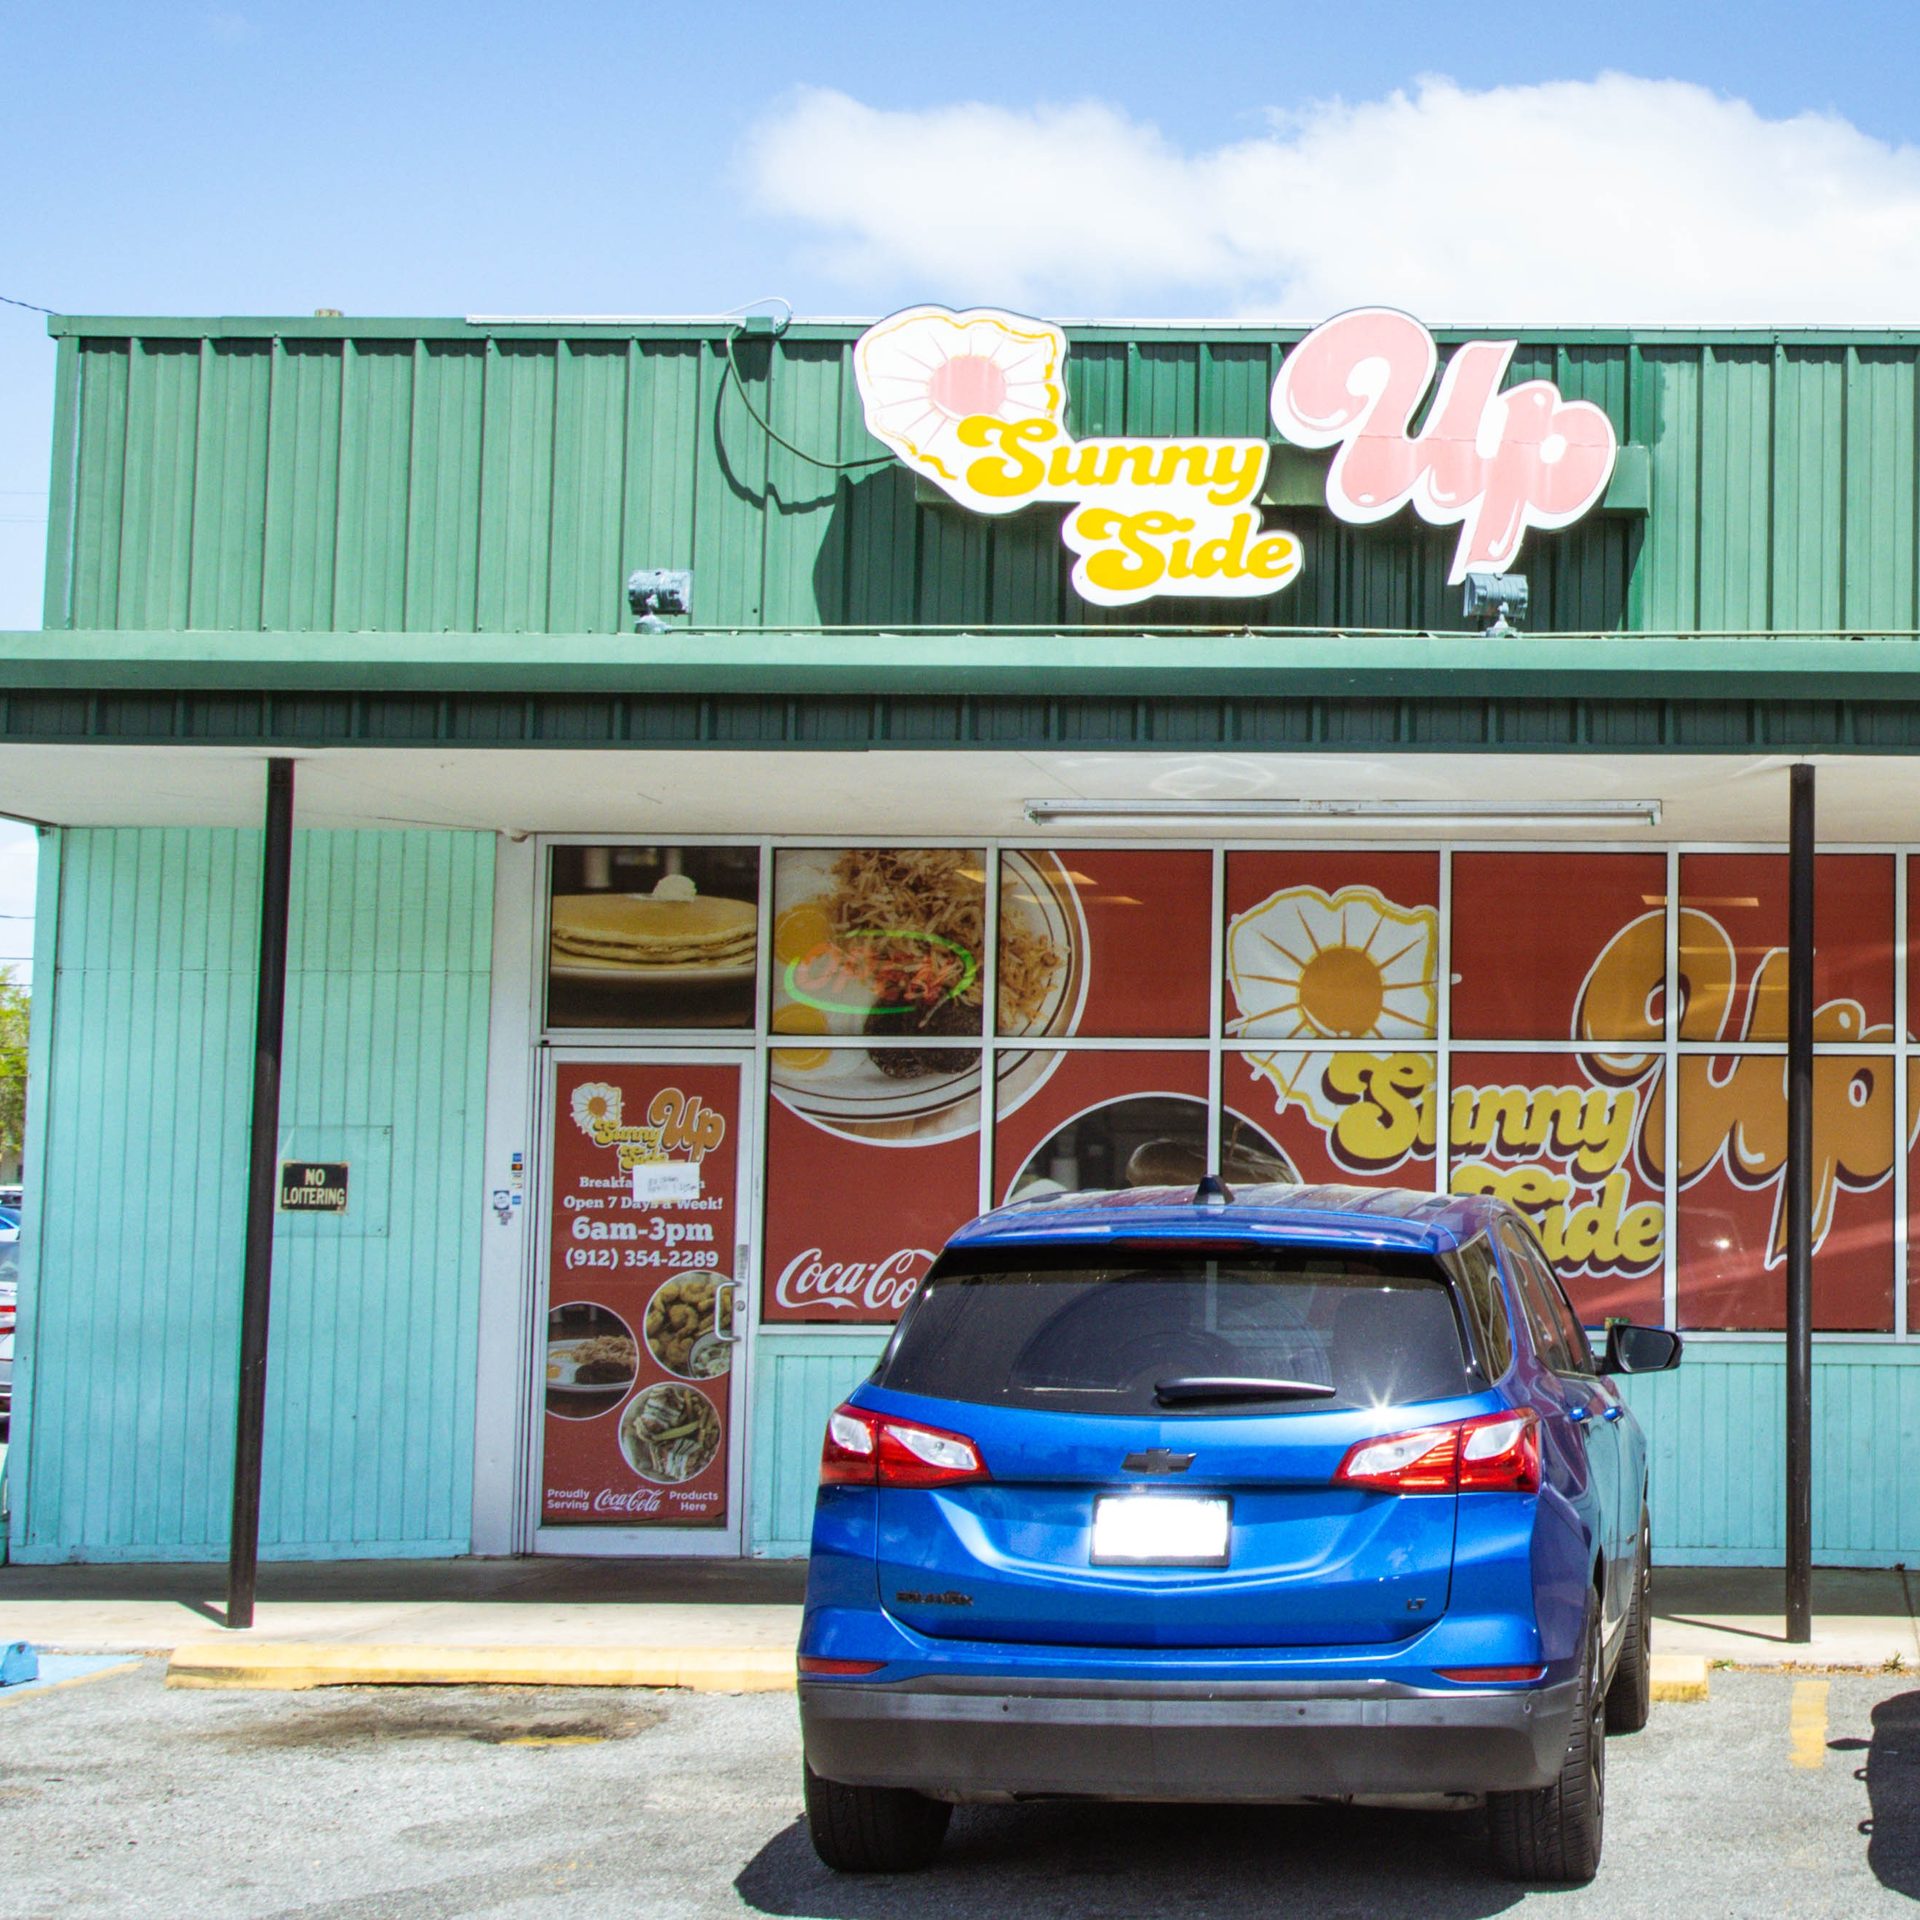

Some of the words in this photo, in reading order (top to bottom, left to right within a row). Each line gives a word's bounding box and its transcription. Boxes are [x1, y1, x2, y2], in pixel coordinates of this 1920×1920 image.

[1274, 309, 1616, 570] Up
[956, 413, 1265, 507] Sunny
[1076, 507, 1296, 592] Side
[1574, 908, 1919, 1270] Up
[648, 1088, 725, 1163] Up
[1320, 1050, 1638, 1185] Sunny
[592, 1119, 661, 1148] Sunny
[304, 1168, 326, 1186] NO
[579, 1176, 633, 1189] Breakfa
[282, 1187, 345, 1205] LOITERING
[563, 1196, 604, 1211] Open
[608, 1196, 617, 1208] 7
[677, 1197, 723, 1210] Week!
[572, 1216, 714, 1247] 6am-3pm
[565, 1248, 619, 1270] (912)
[624, 1250, 719, 1268] 354-2289
[776, 1248, 938, 1309] Coca-Co
[547, 1489, 590, 1499] Proudly
[547, 1500, 589, 1511] Serving
[593, 1488, 666, 1512] Coca-Cola
[669, 1491, 719, 1501] Products
[680, 1501, 707, 1511] Here
